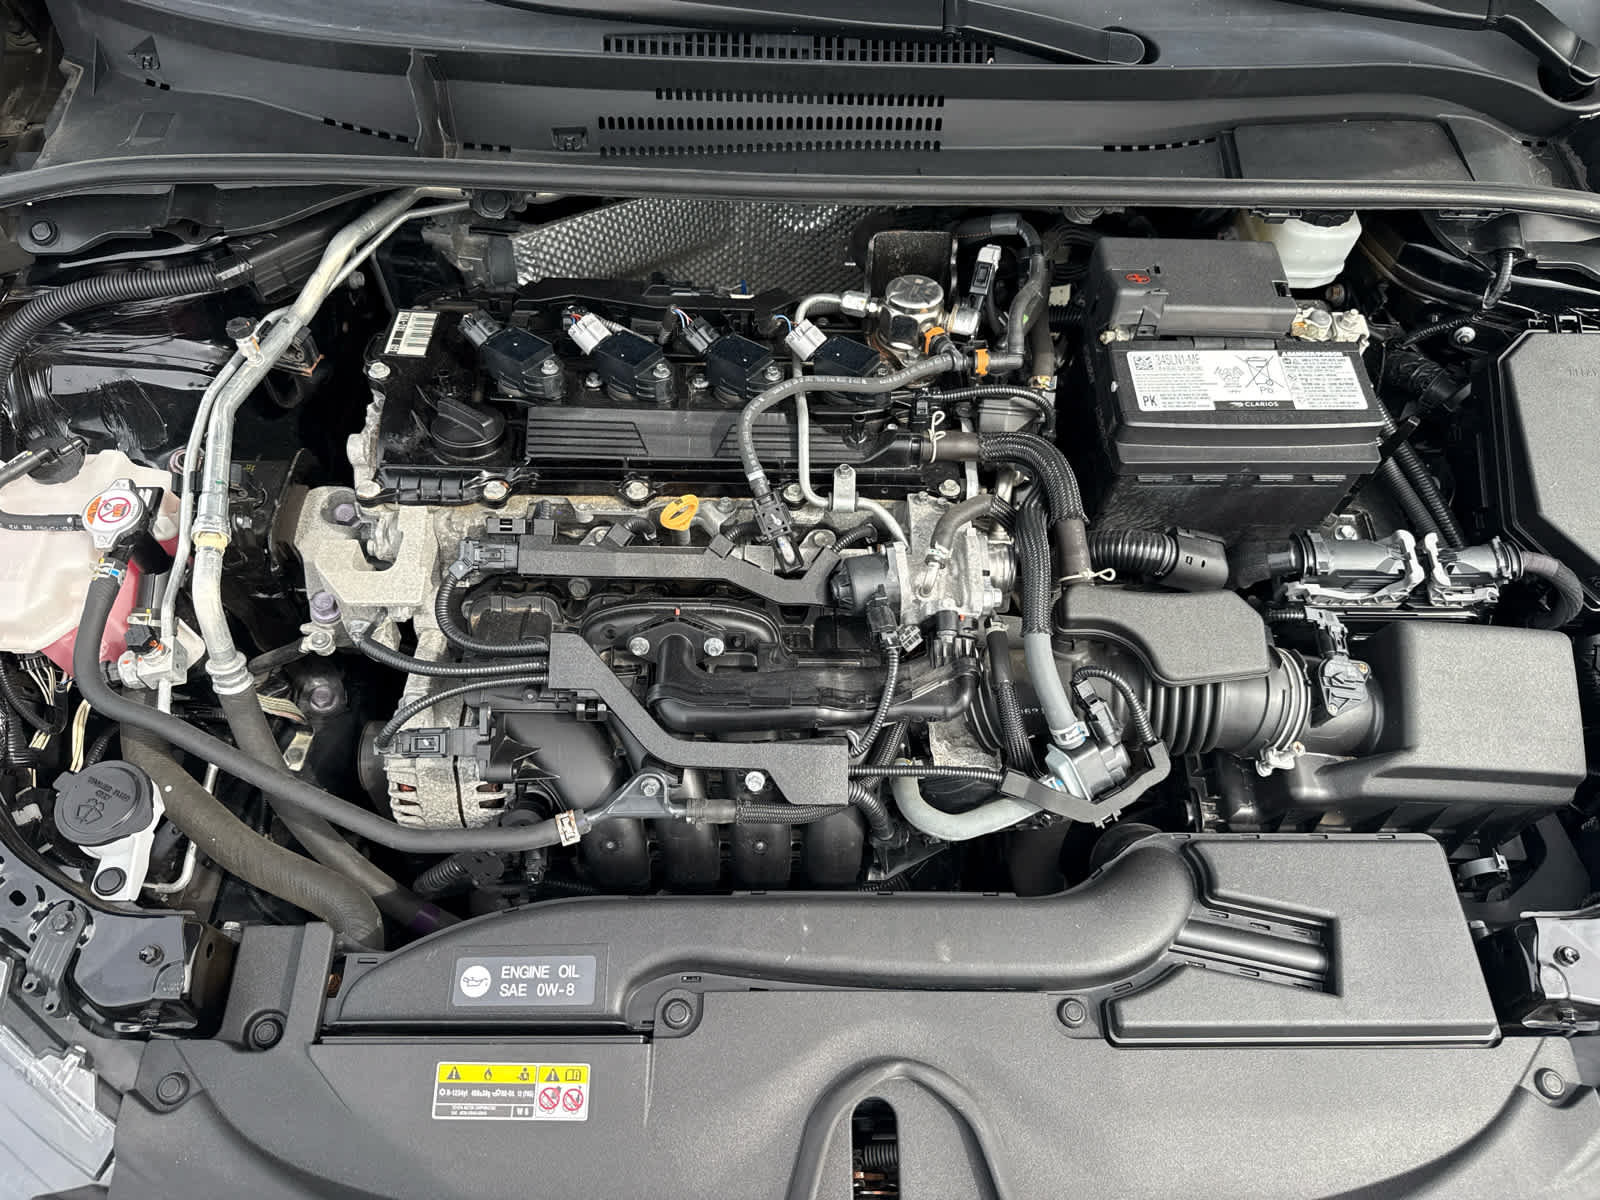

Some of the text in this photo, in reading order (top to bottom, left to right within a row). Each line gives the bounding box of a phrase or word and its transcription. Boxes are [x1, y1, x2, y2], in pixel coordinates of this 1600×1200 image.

[1142, 395, 1158, 407] PK
[1244, 400, 1279, 408] CLARIOS
[501, 964, 580, 979] ENGINE OIL
[499, 983, 575, 997] SAE 0W-8
